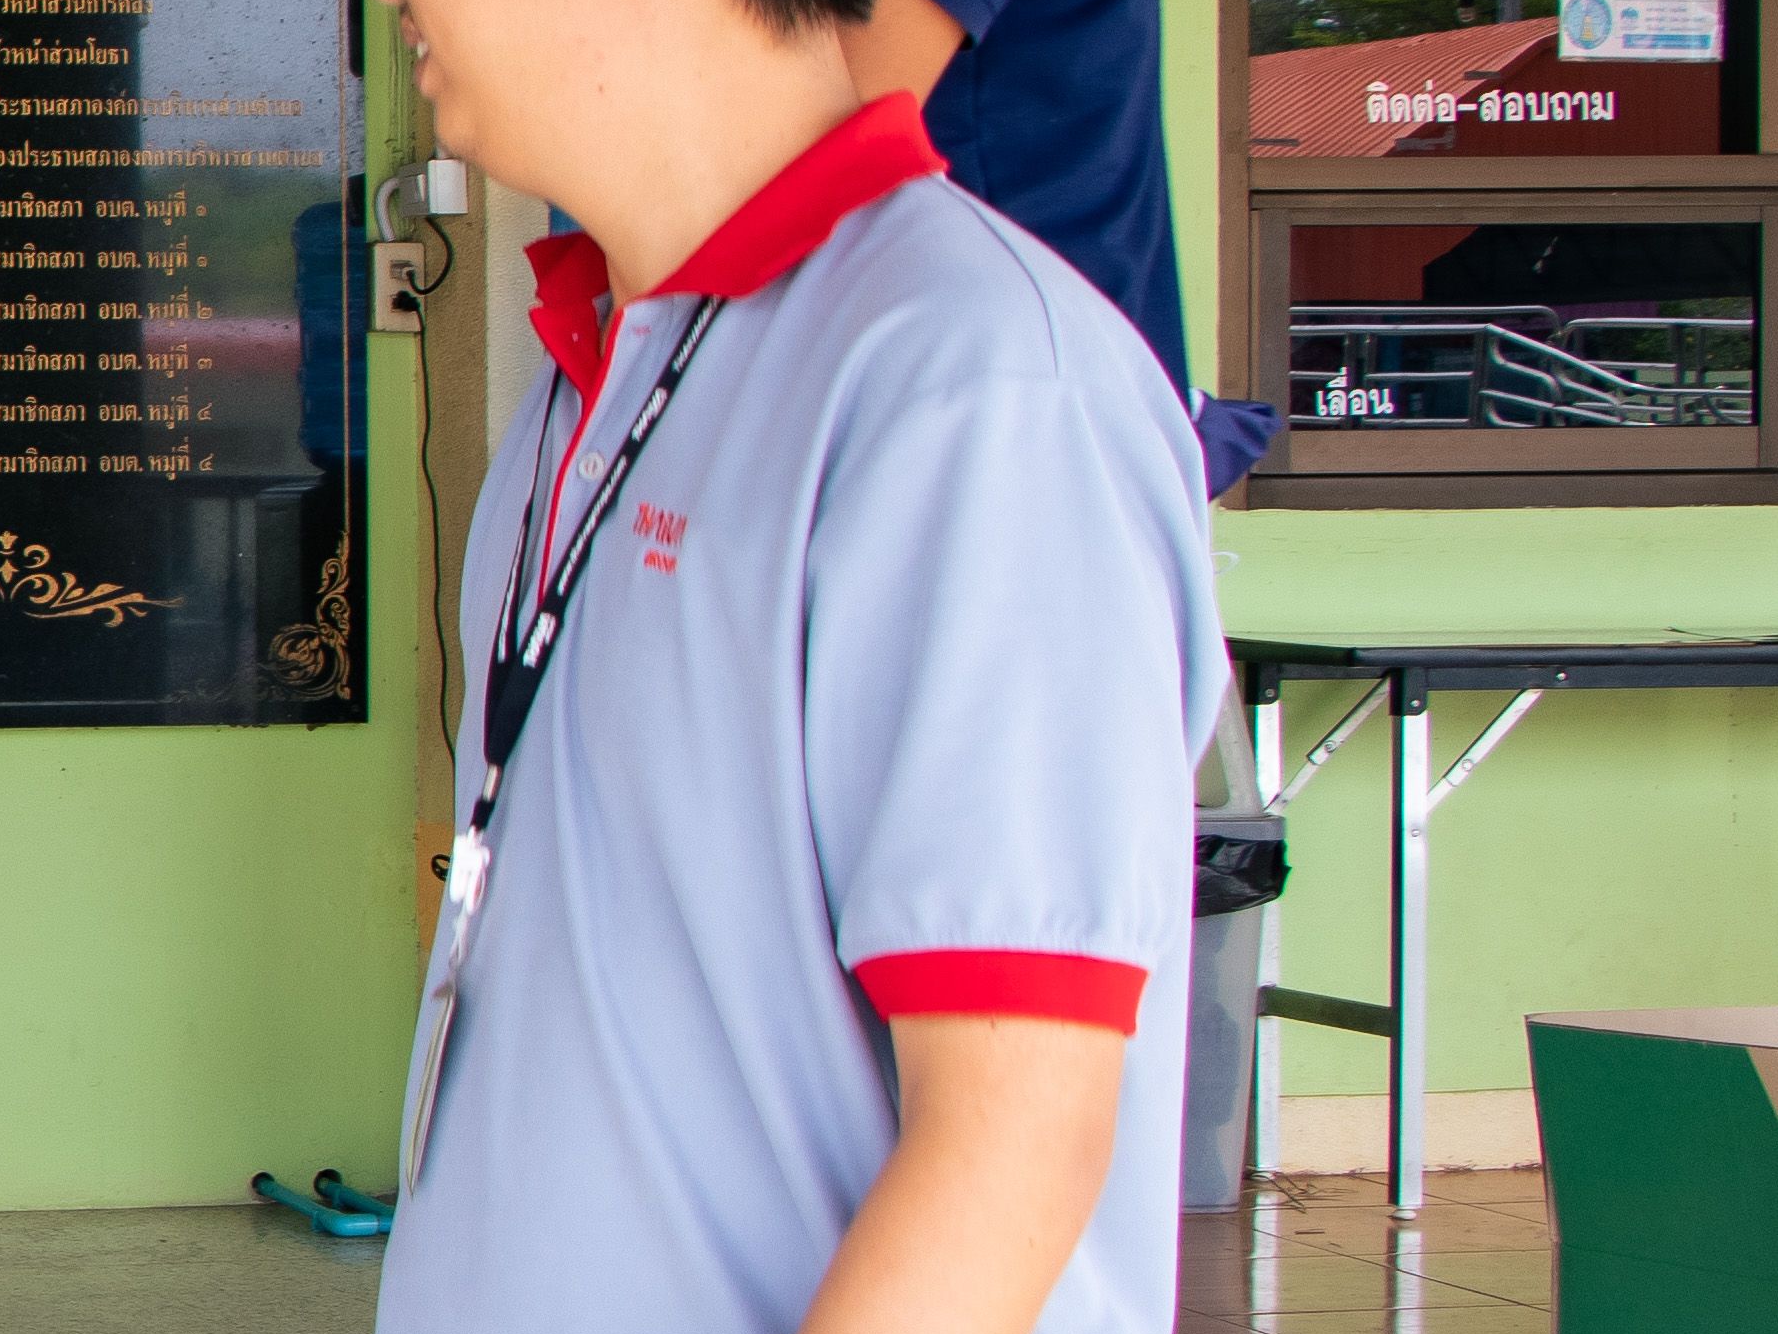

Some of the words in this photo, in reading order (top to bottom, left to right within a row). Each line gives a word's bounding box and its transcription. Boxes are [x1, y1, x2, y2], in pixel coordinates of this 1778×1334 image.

[1366, 80, 1616, 124] ติดต่อ-สอบถาม
[96, 199, 140, 219] อบต.
[145, 185, 188, 227] หมู่ที่
[97, 250, 140, 268] อบต.
[147, 236, 190, 277] หมู่ที่
[99, 301, 141, 321] อบต.
[99, 352, 142, 371] อบต.
[99, 402, 141, 422] อบต.
[147, 387, 192, 430] หมู่ที่
[1315, 367, 1394, 417] เลื่อน
[100, 454, 144, 474] อบต.
[148, 437, 193, 481] หมู่ที่
